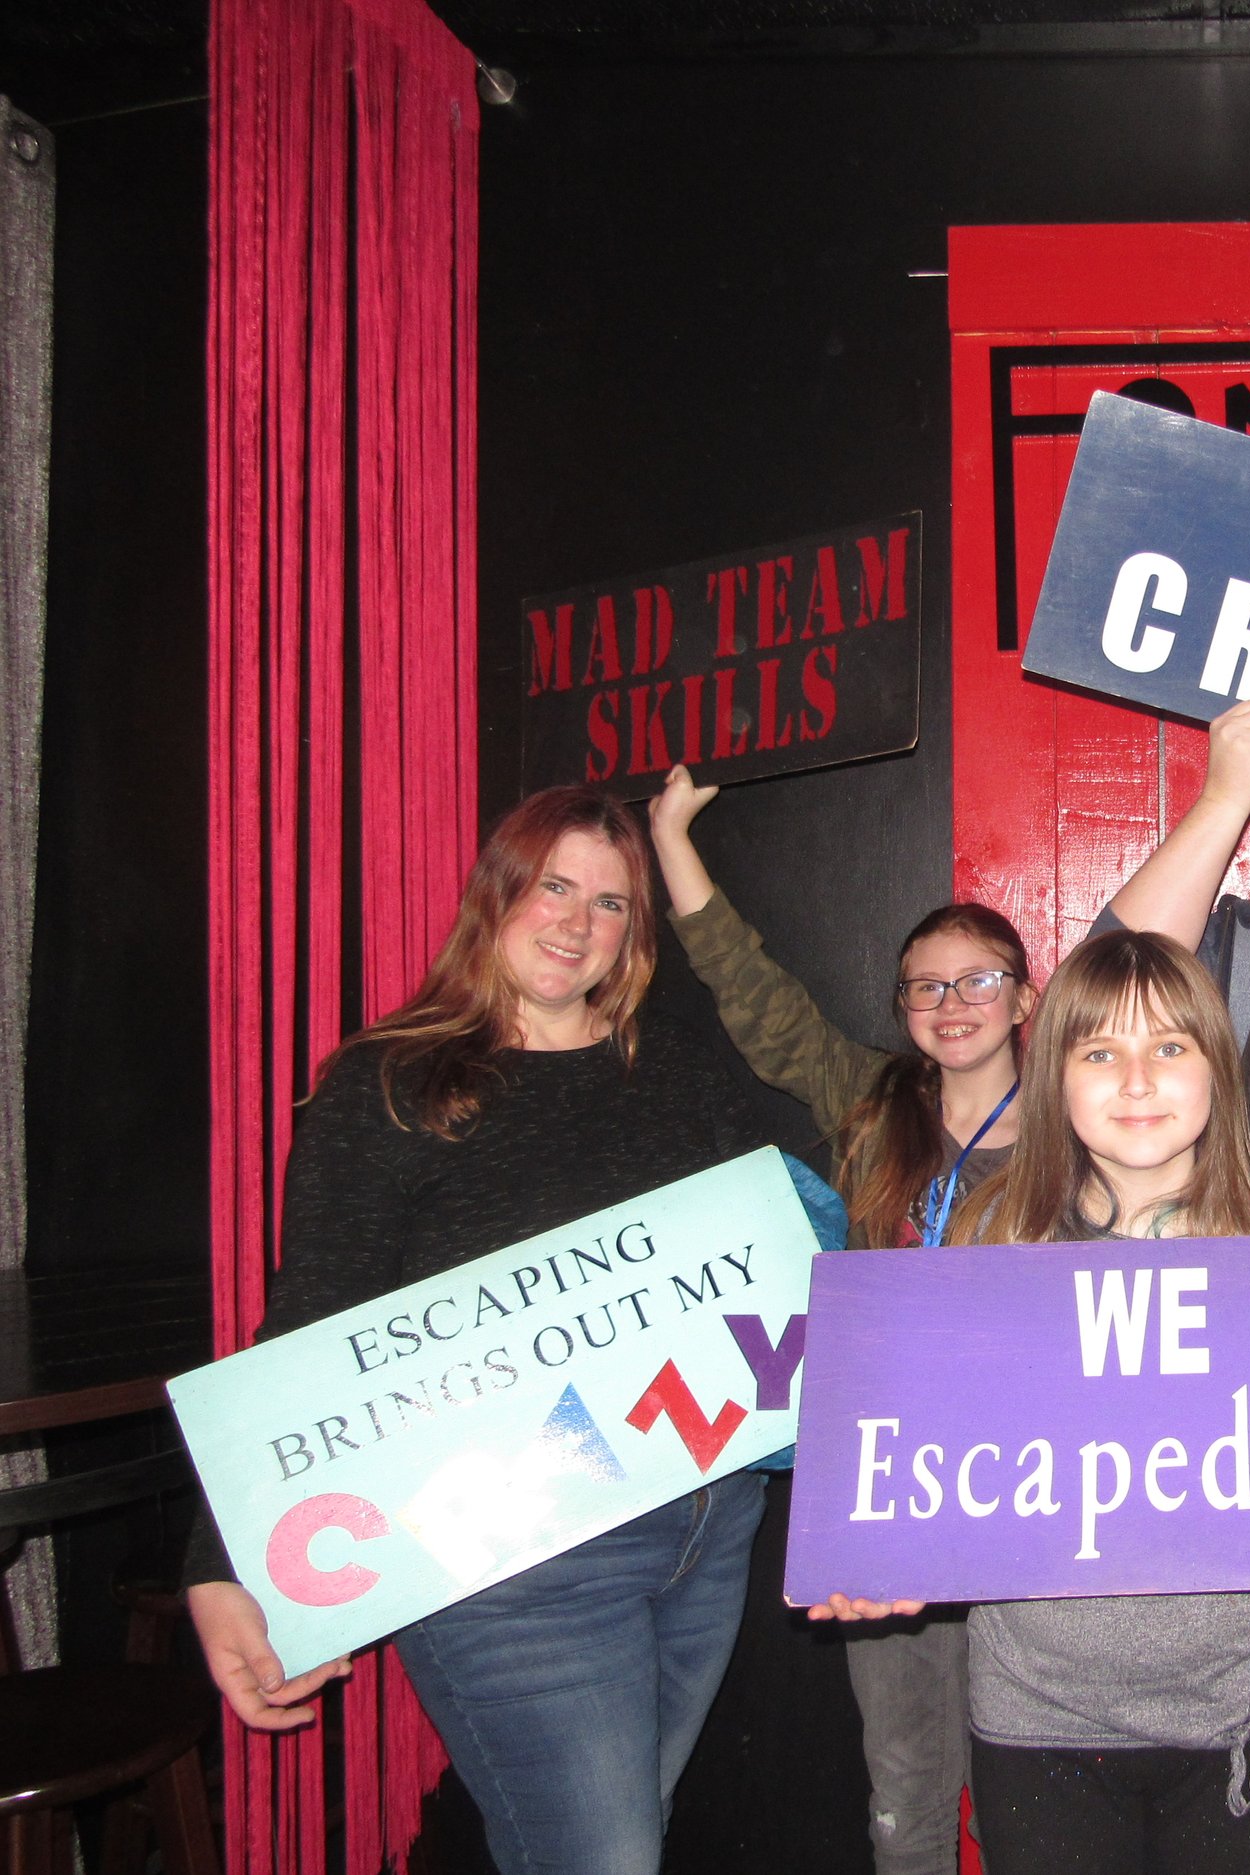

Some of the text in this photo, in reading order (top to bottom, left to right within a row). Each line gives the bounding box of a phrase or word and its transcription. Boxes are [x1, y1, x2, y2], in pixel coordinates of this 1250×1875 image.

[527, 528, 910, 697] MAD TEAM
[586, 644, 838, 783] SKILLS
[266, 1243, 757, 1482] BRINGS OUT MY
[342, 1221, 657, 1376] ESCAPING
[1074, 1267, 1211, 1378] WE
[266, 1314, 808, 1607] CAZY
